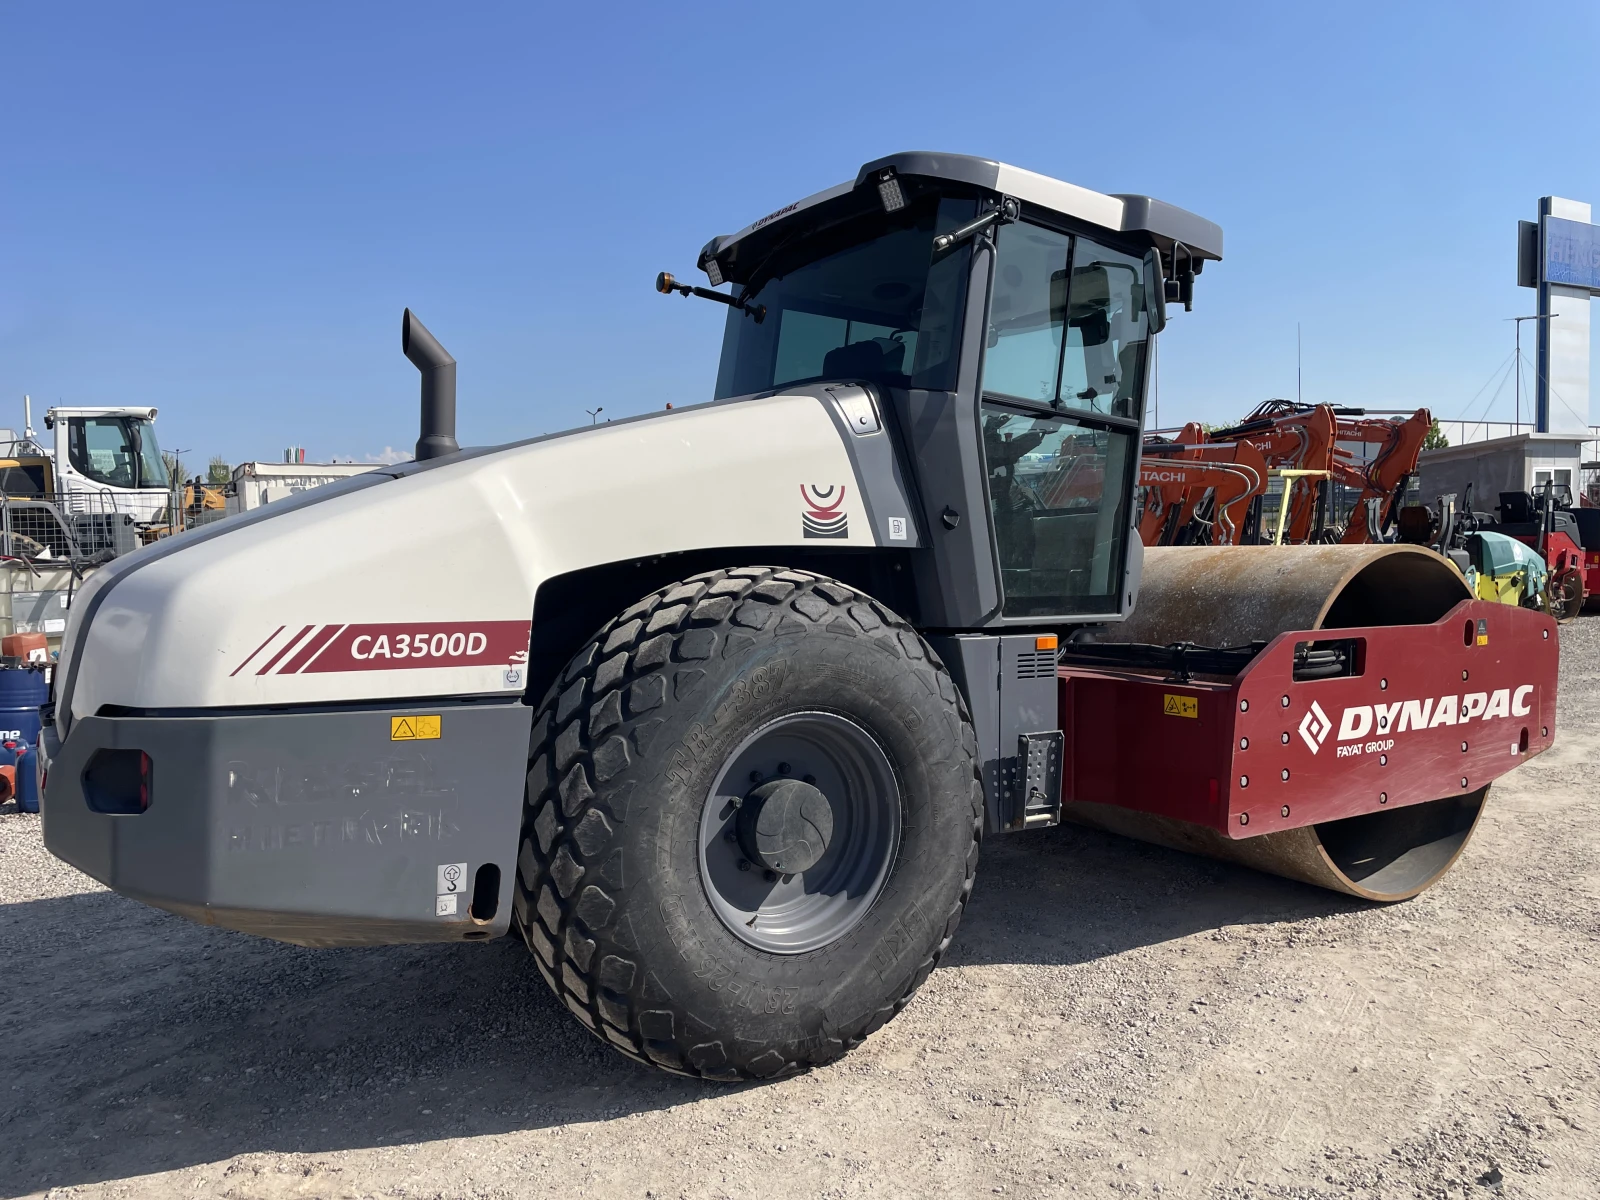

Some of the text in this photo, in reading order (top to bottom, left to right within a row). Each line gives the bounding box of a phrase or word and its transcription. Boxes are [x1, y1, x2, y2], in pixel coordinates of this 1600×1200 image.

[1255, 440, 1272, 451] CHI
[1140, 471, 1186, 483] TACHI
[350, 632, 487, 660] CA3500D
[1337, 684, 1534, 741] DYNAPAC
[0, 730, 21, 740] ne
[1337, 739, 1394, 758] FAYAT GROUP
